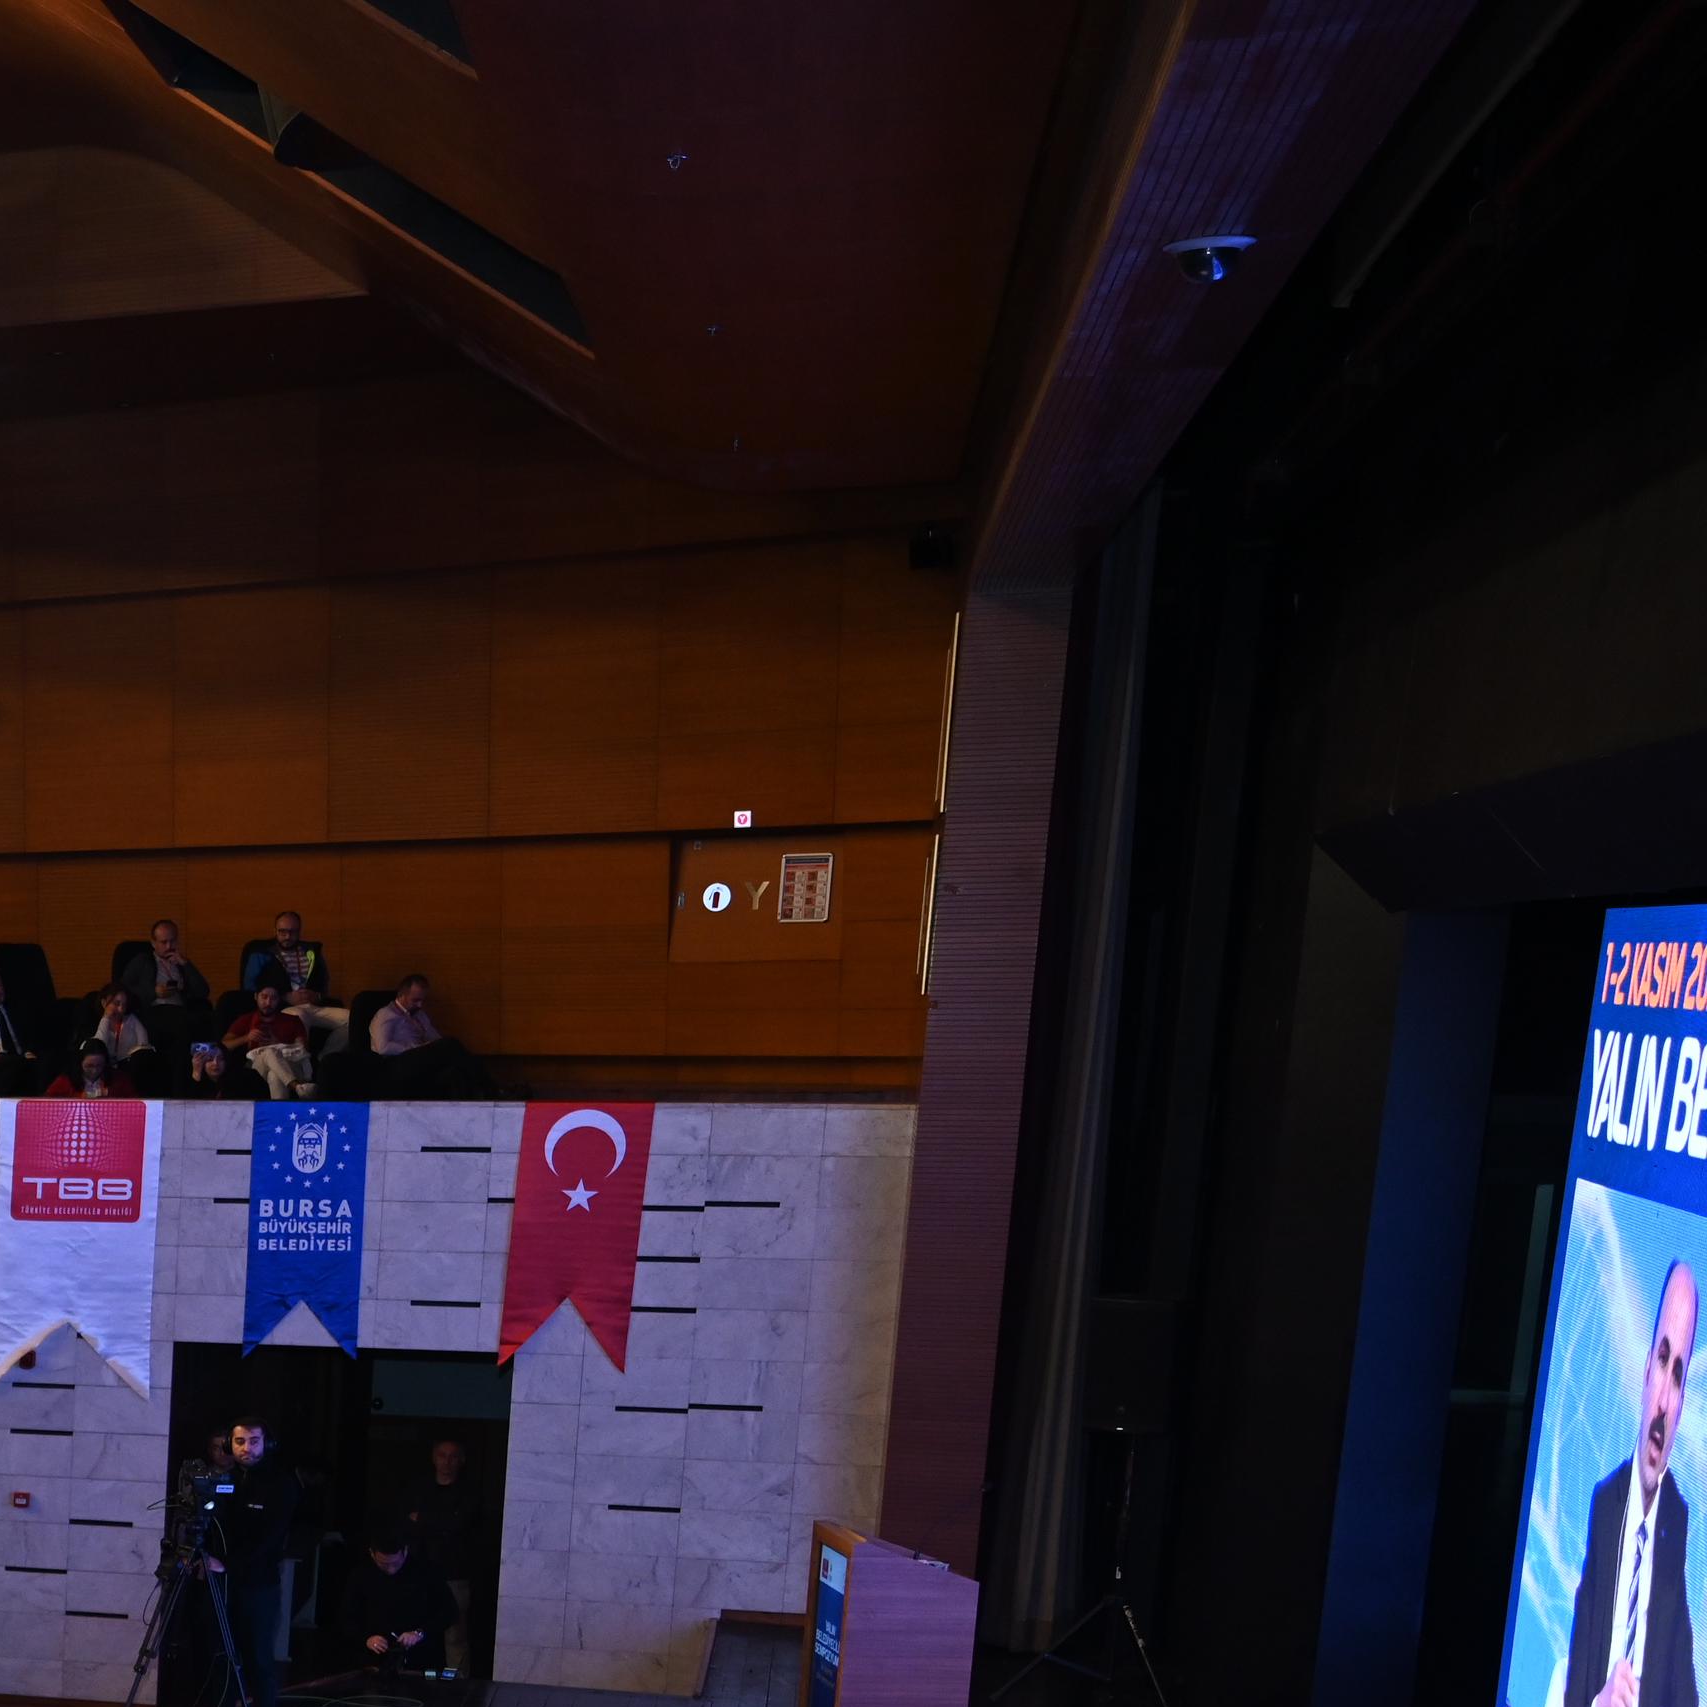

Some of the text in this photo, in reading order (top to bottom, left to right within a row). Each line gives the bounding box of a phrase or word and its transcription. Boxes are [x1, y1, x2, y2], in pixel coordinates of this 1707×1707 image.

[1601, 942, 1632, 1005] 1-2
[1627, 942, 1688, 1009] KASIM
[1587, 1028, 1672, 1152] YALIN
[22, 1177, 133, 1201] TBB
[258, 1199, 353, 1218] BURSA
[258, 1218, 352, 1236] BÜYÜKŞEHİR
[257, 1235, 352, 1252] BELEDİYESİ
